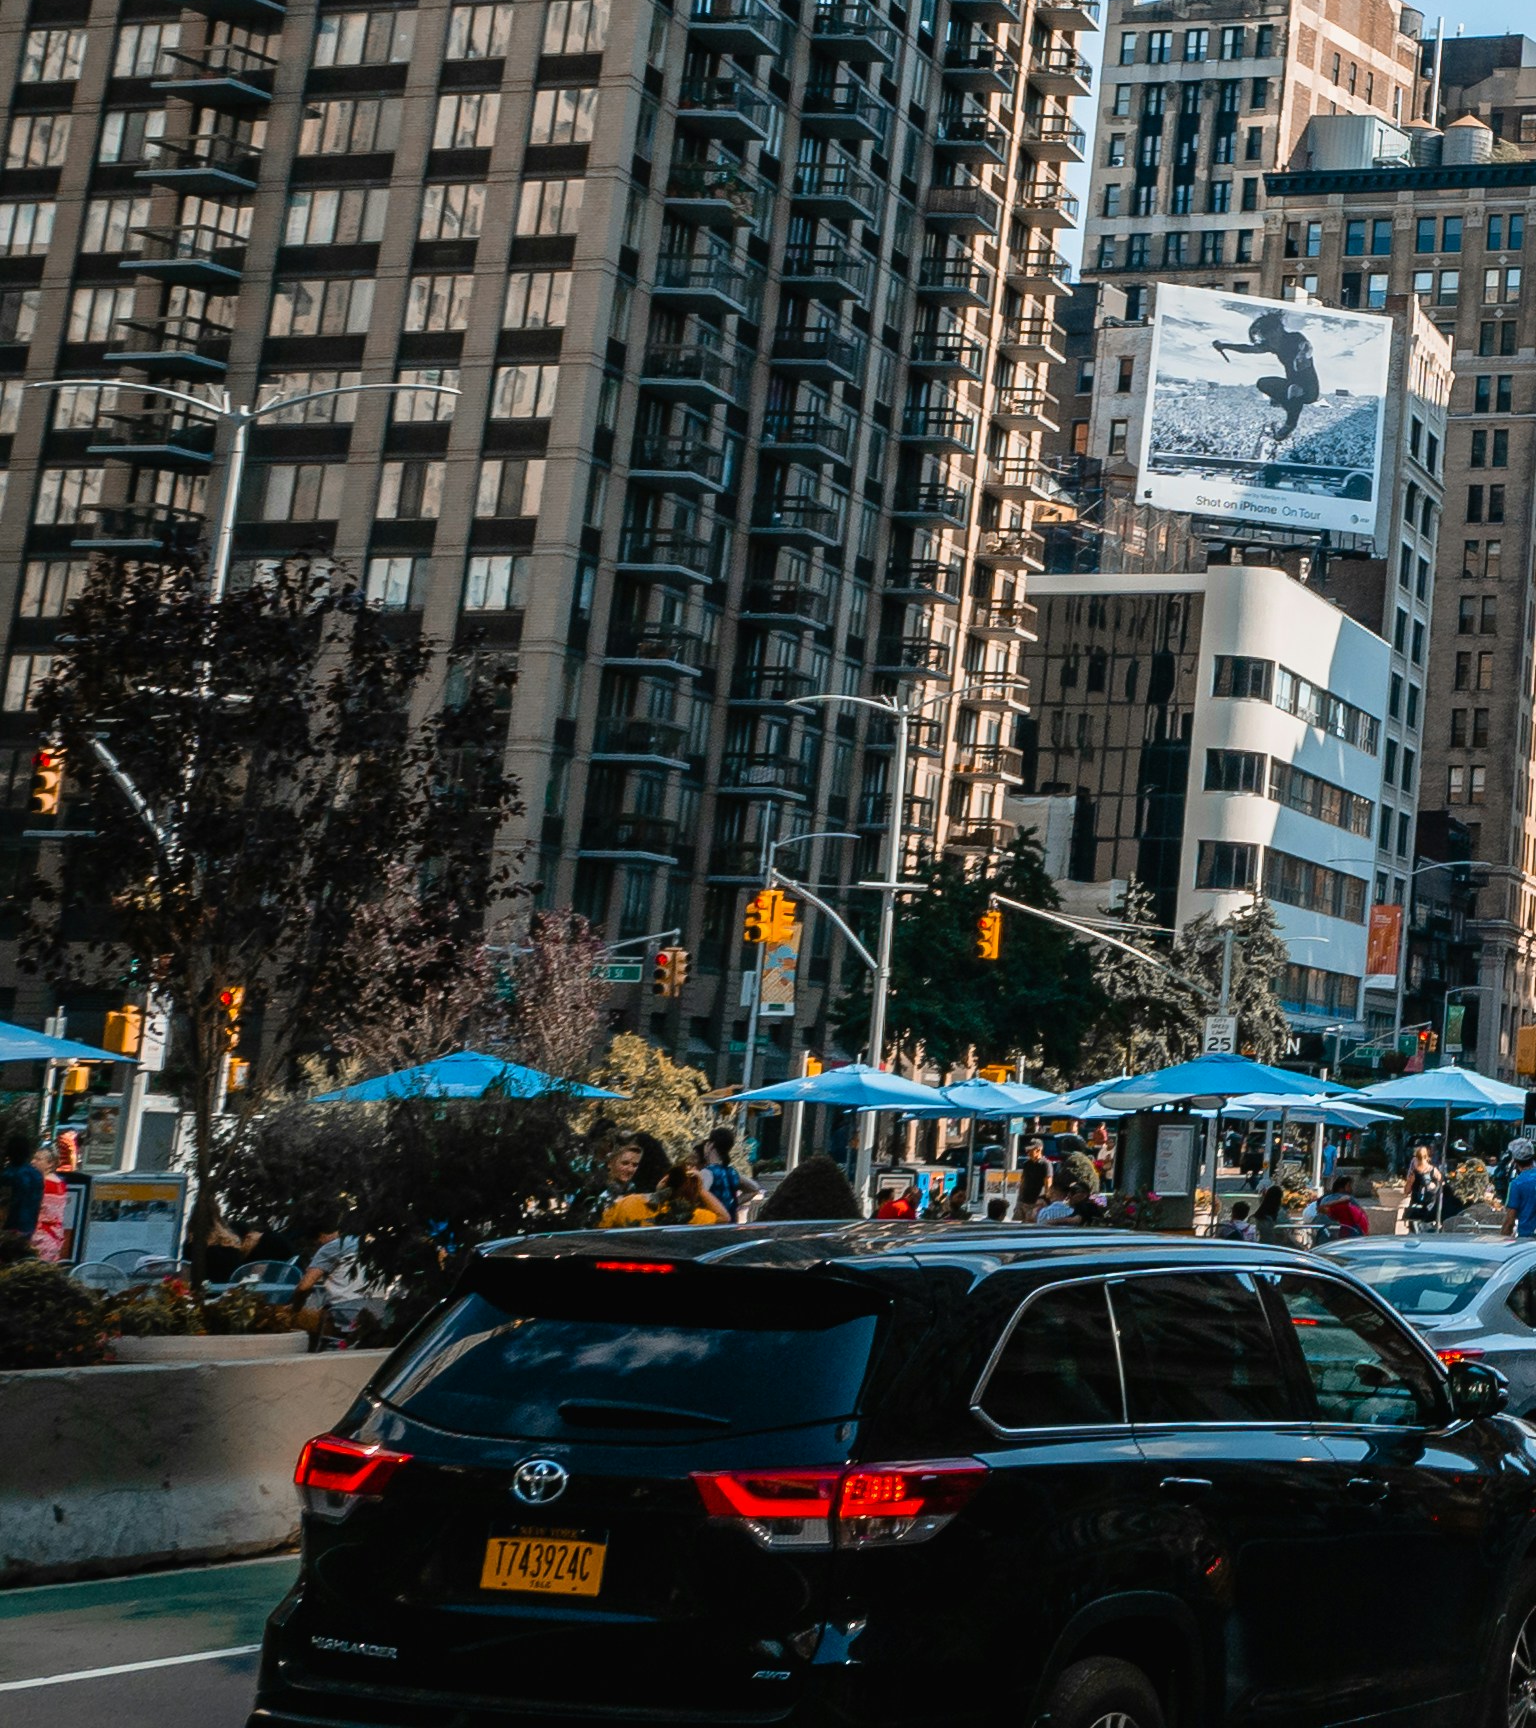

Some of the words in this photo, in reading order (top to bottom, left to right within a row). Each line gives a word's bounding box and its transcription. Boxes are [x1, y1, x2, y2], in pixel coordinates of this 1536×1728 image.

[1195, 495, 1221, 508] Shot
[1223, 501, 1238, 510] on
[1239, 500, 1278, 515] iPhone
[1281, 505, 1298, 518] On
[1298, 508, 1322, 521] Tour
[1206, 1036, 1232, 1052] 25
[495, 1540, 593, 1582] T743924C
